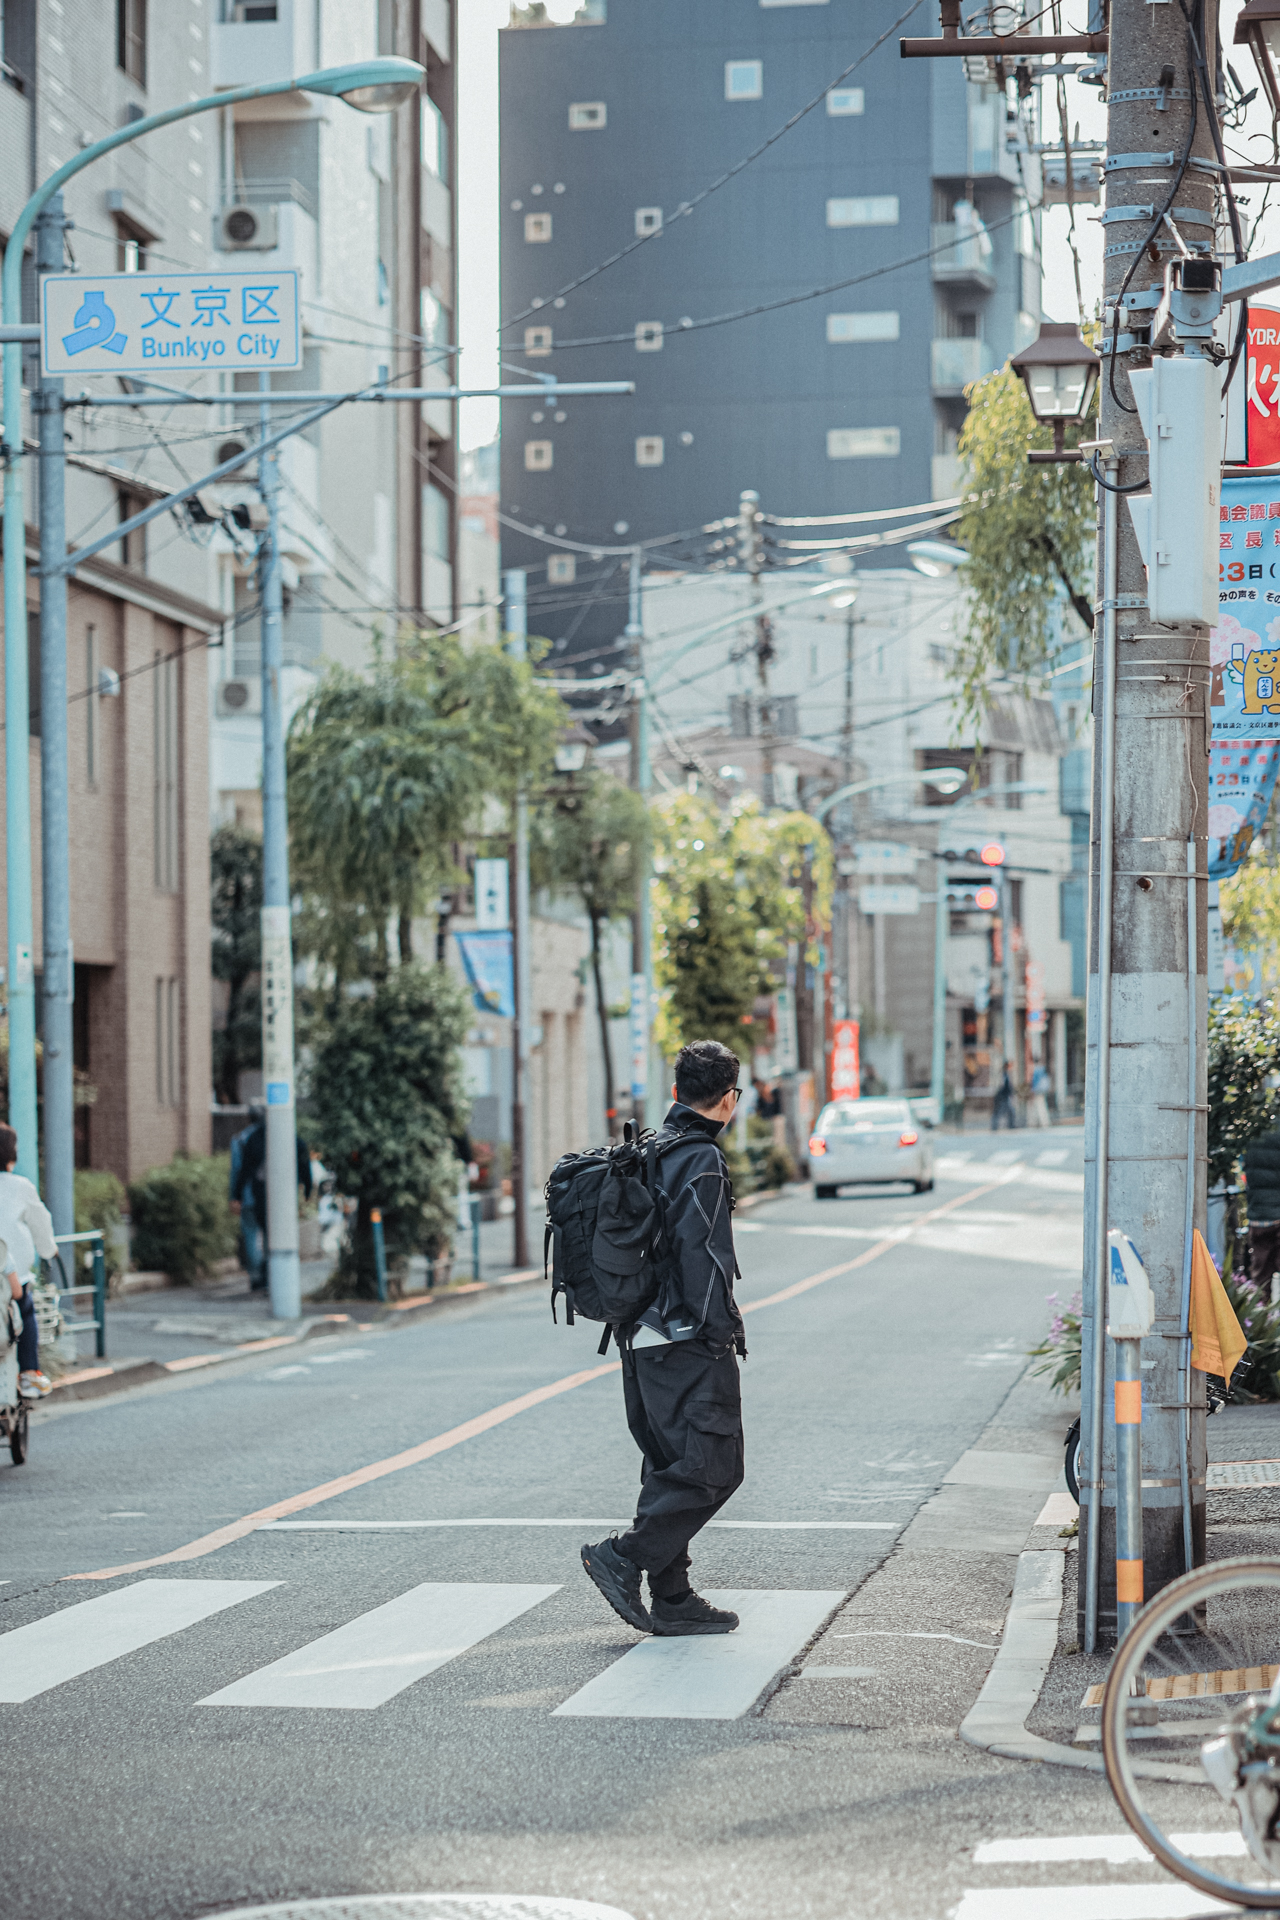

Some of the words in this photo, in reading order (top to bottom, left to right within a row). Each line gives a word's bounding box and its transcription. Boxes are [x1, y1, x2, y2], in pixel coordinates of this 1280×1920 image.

[140, 286, 280, 329] 文京区
[141, 336, 226, 361] Bunkyo
[237, 333, 280, 359] City
